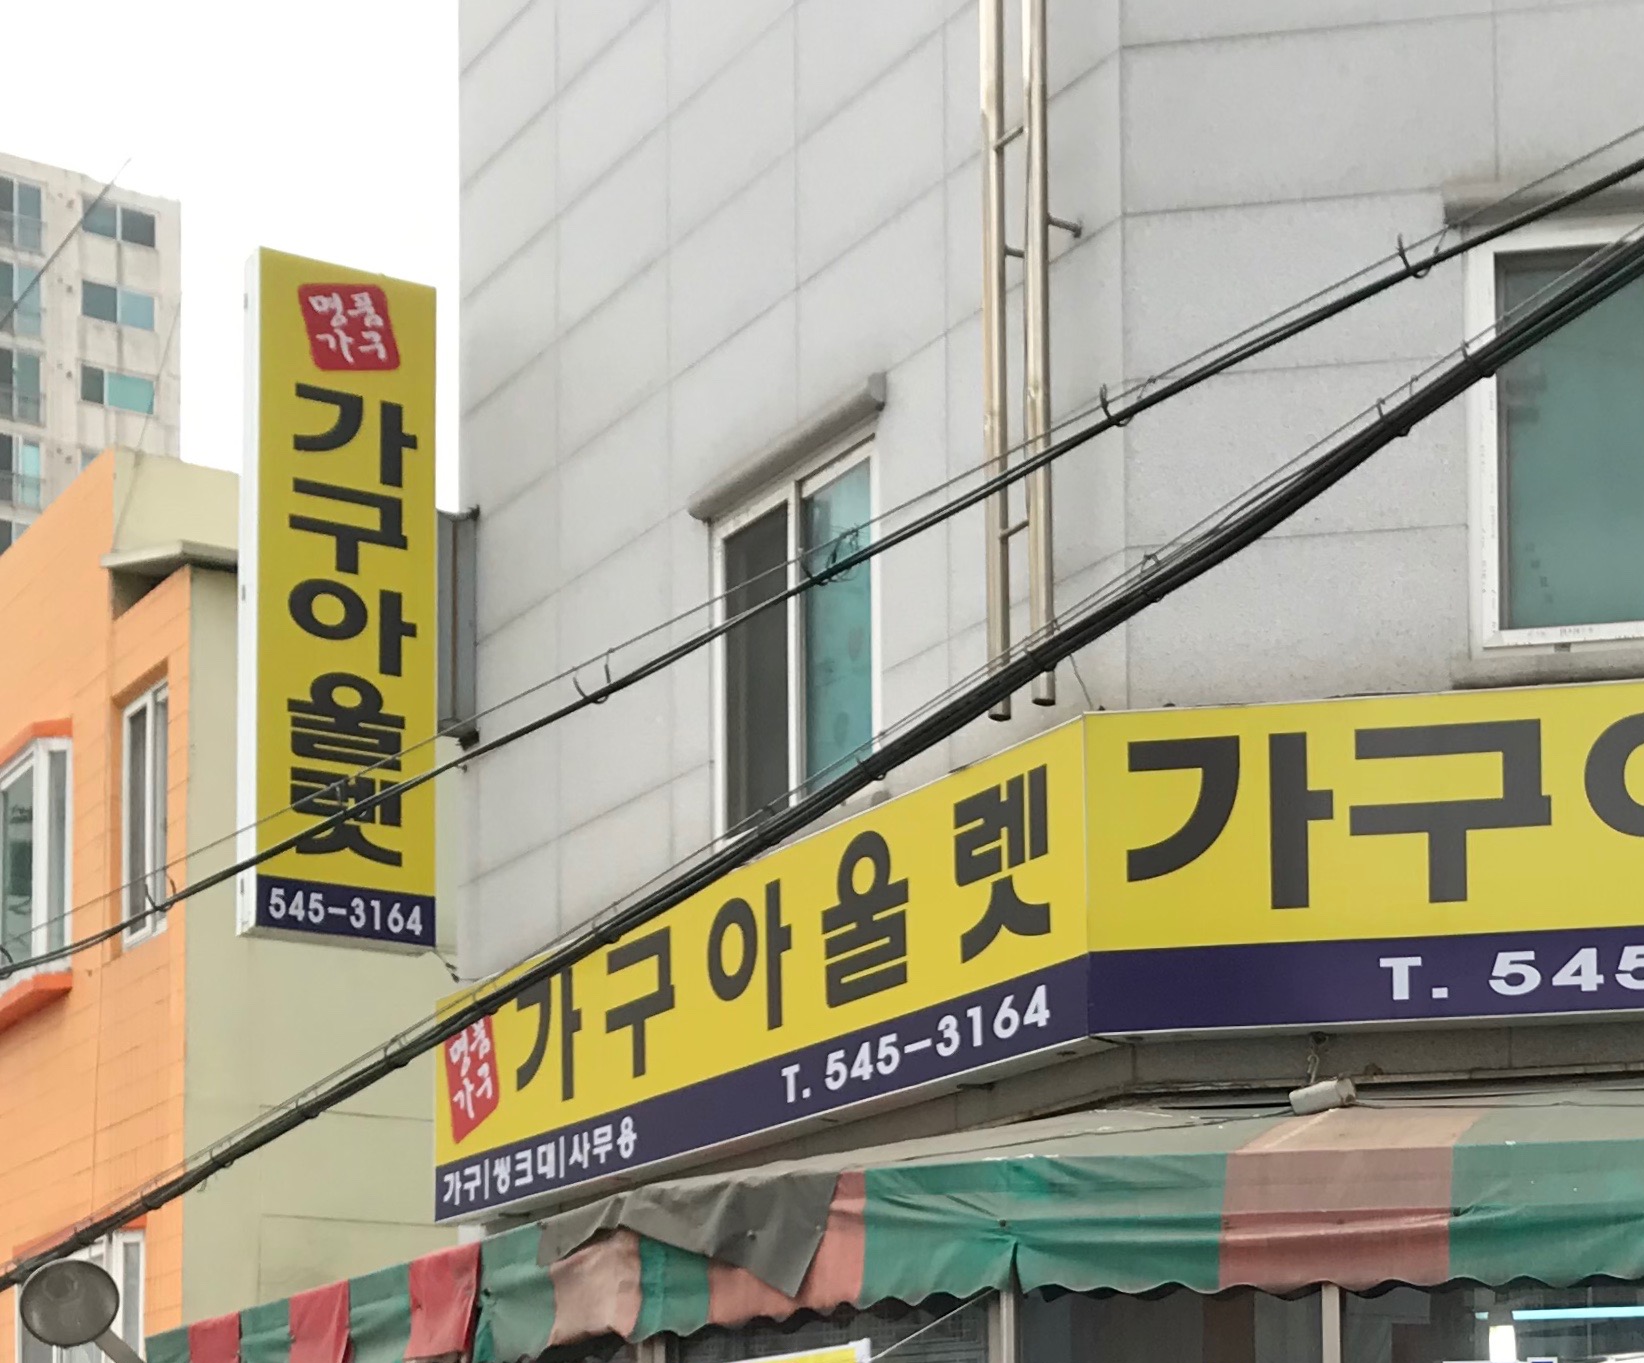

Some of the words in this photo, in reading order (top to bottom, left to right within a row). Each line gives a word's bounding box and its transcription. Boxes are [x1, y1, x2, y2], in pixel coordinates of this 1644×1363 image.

[315, 330, 388, 364] 가구
[288, 383, 418, 867] 가구아울렛
[269, 887, 424, 936] 545-3164
[516, 764, 1052, 1101] 가구아울렛
[1380, 956, 1449, 1001] T.
[782, 1065, 812, 1103] T.
[825, 984, 1052, 1092] 545-3164
